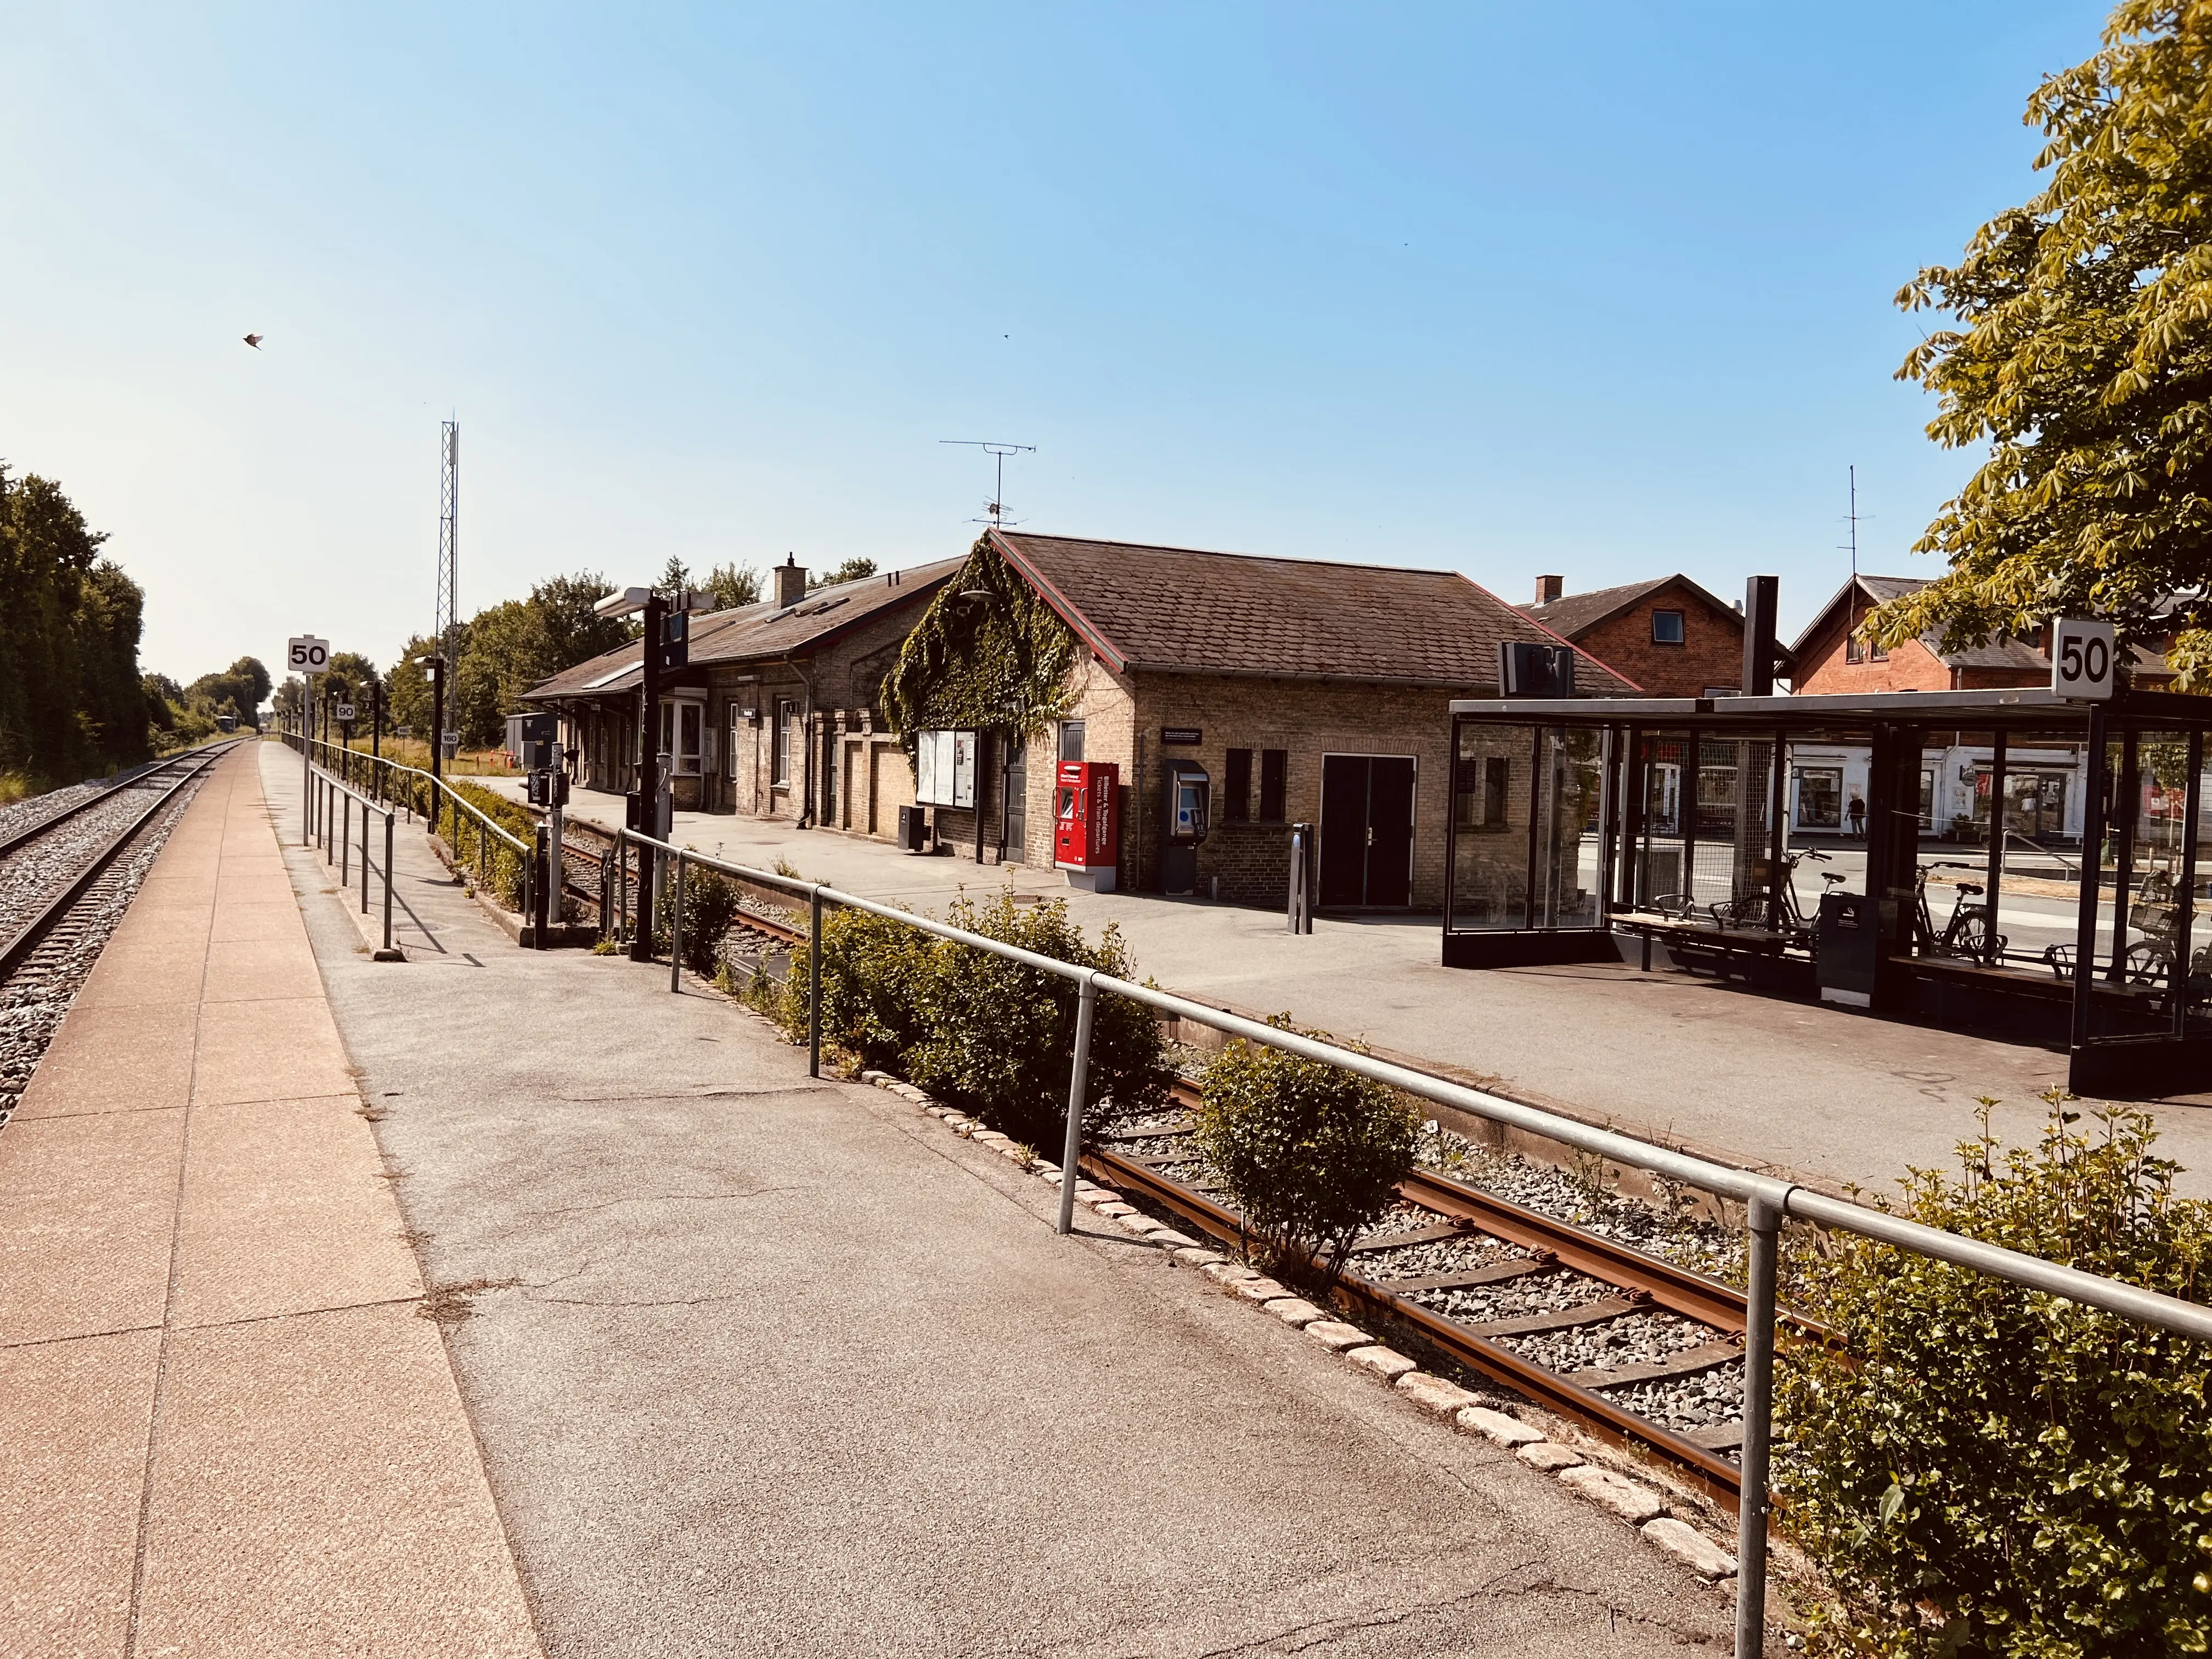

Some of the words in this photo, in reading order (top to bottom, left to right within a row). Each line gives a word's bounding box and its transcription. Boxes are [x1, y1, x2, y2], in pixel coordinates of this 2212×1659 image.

[291, 645, 326, 665] 50
[2061, 636, 2108, 683] 50
[339, 707, 353, 716] 90
